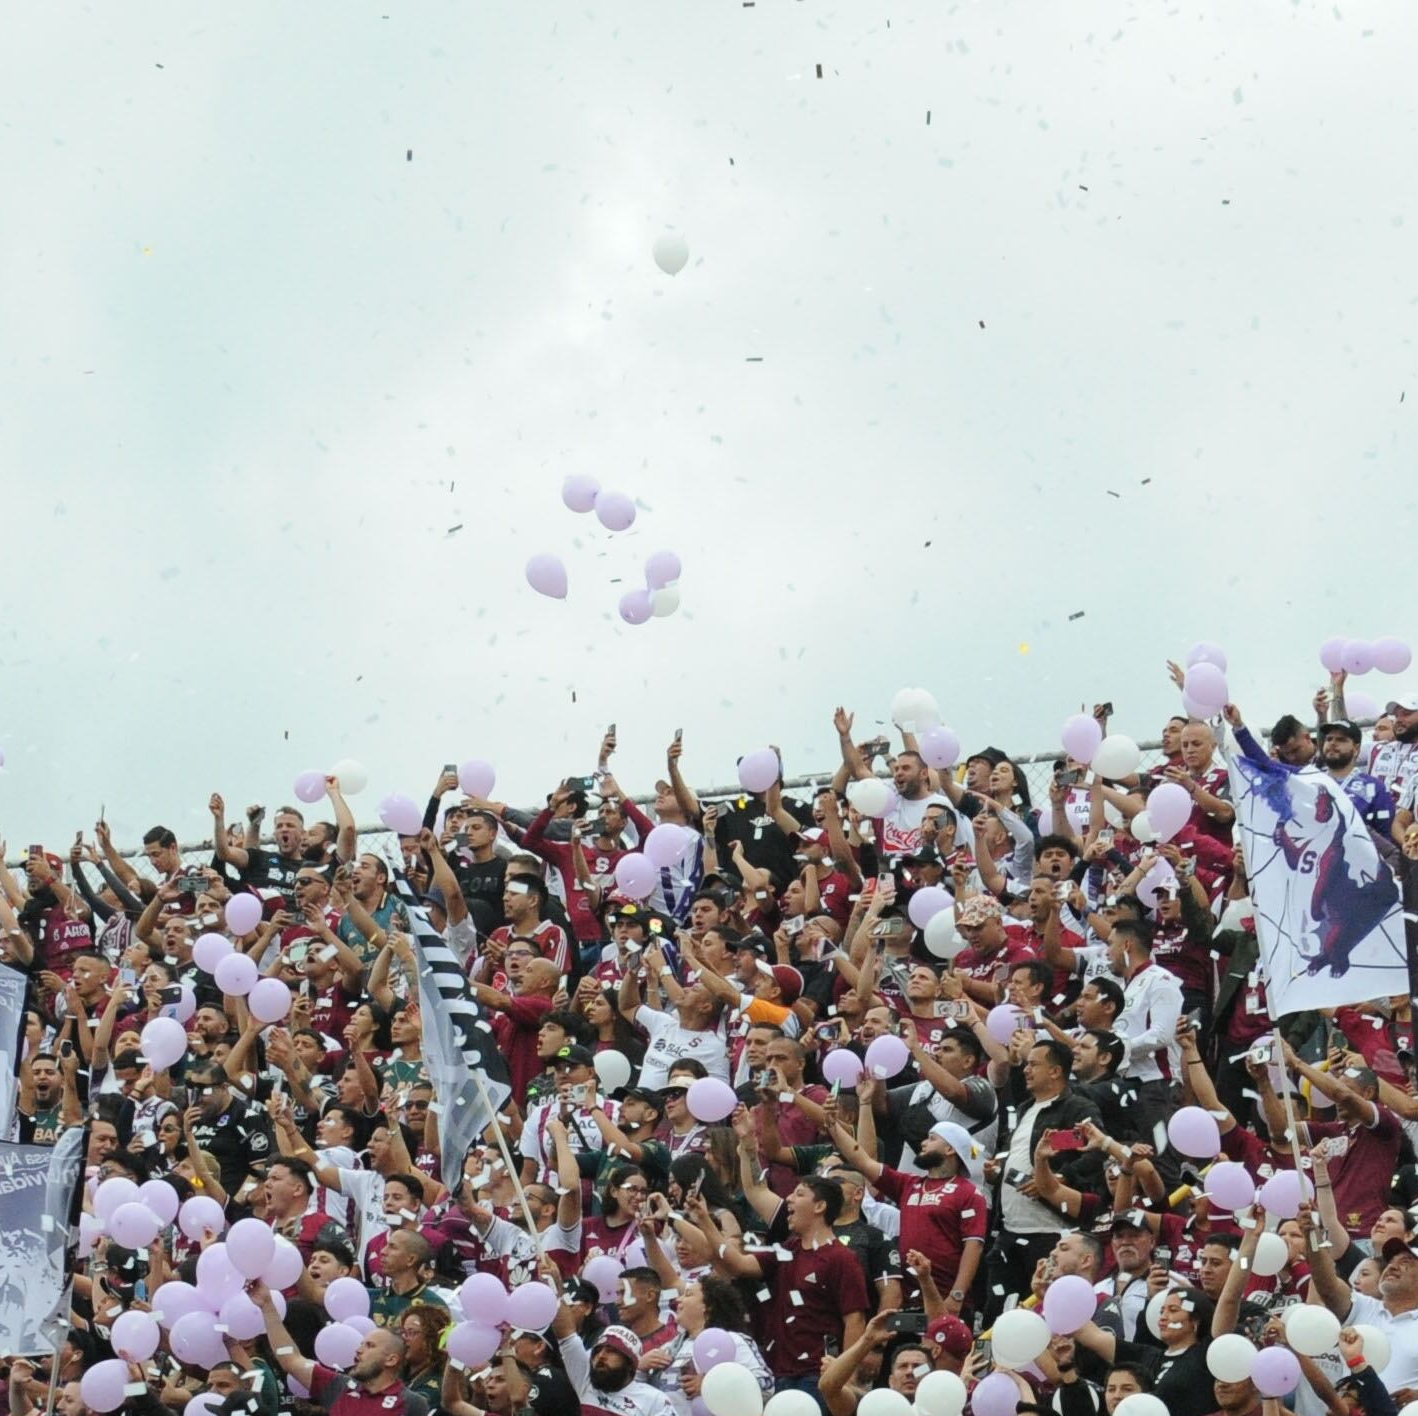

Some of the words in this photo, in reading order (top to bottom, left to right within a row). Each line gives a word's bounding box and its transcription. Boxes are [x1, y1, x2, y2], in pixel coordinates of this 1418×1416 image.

[1075, 806, 1090, 814] BA
[596, 858, 610, 872] S
[1300, 851, 1317, 873] S
[1095, 964, 1109, 975] BA
[931, 1030, 943, 1041] S
[919, 1043, 939, 1055] AC
[417, 1156, 435, 1164] AC
[921, 1194, 944, 1206] BAC
[383, 1396, 395, 1408] S
